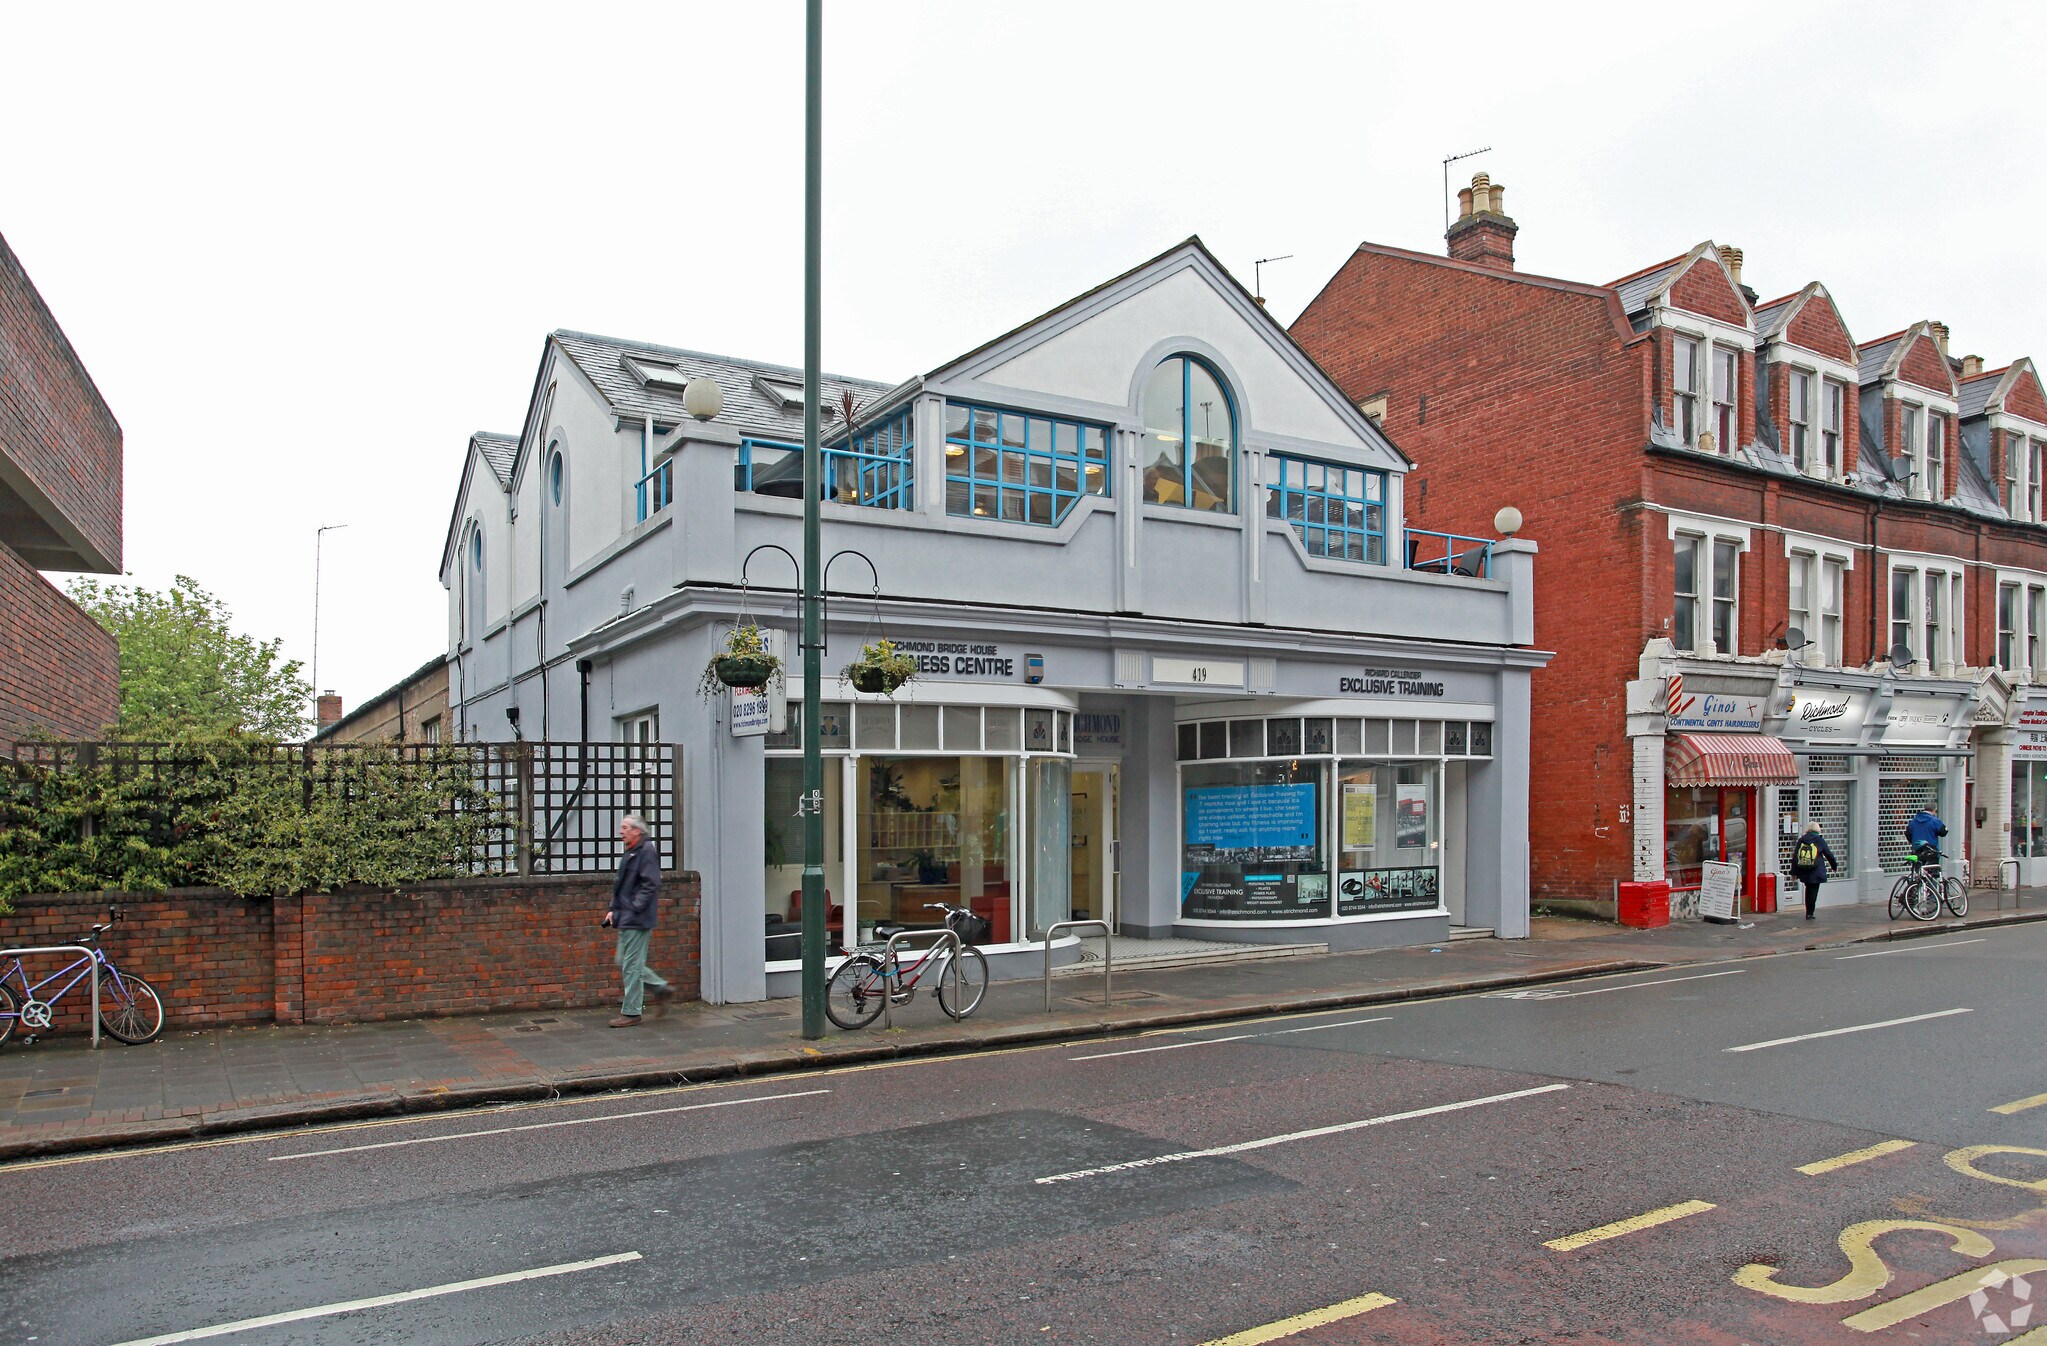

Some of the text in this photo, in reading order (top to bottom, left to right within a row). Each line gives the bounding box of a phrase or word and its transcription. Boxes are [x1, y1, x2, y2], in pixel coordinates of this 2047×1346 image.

[938, 643, 968, 654] BRIDGE
[970, 645, 998, 655] HOUSE
[955, 656, 1013, 676] CENTRE
[1192, 667, 1207, 681] 419
[1364, 668, 1422, 680] RICHARD CALLENDER
[1340, 677, 1444, 697] EXCLUSIVE TRAINING
[1703, 695, 1736, 716] Gino's
[1801, 696, 1851, 721] Richmond
[1074, 714, 1120, 733] ICHMOND
[1670, 719, 1760, 729] CONTINENTAL GENTS HAIRDRESSERS
